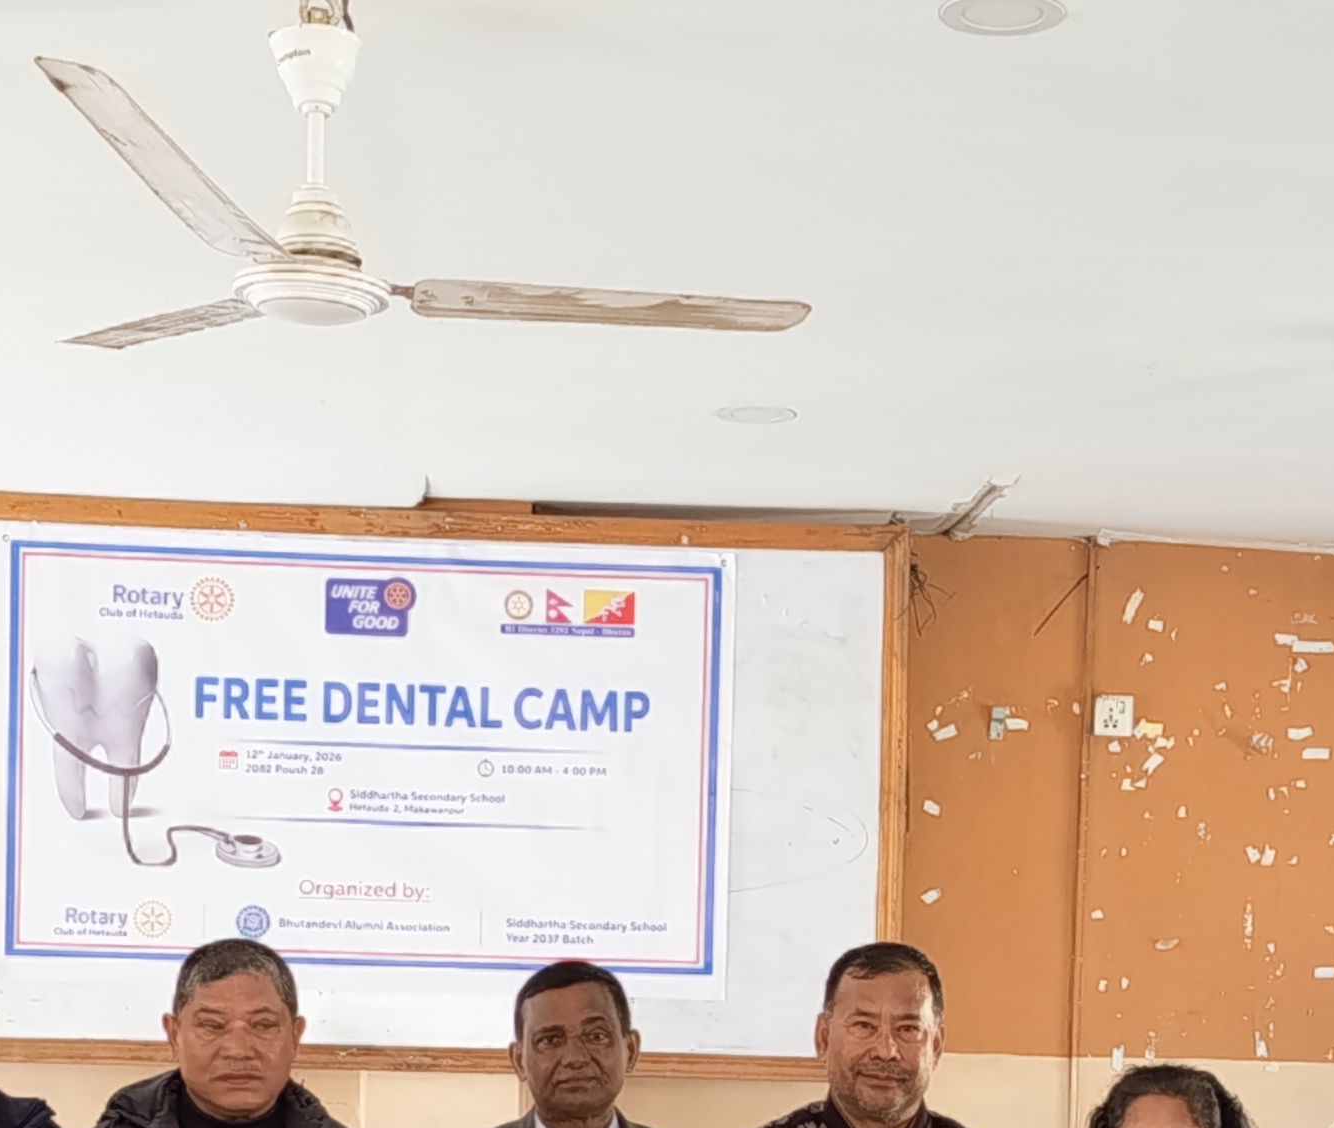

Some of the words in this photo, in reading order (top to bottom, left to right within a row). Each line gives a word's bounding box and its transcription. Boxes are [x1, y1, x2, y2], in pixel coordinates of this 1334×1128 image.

[113, 584, 184, 610] Rotary
[331, 584, 379, 599] UNITE
[99, 607, 123, 618] Club
[126, 608, 137, 618] of
[139, 609, 184, 620] Hetauda
[348, 600, 381, 614] FOR
[352, 615, 400, 630] GOOD
[571, 627, 595, 636] Nepal
[195, 676, 307, 722] FREE
[323, 681, 503, 729] DENTAL
[513, 687, 650, 732] CAMP
[267, 750, 313, 763] January,
[315, 752, 342, 762] 2026
[245, 764, 272, 774] 2082
[275, 764, 308, 774] Poush
[311, 766, 324, 775] 28
[534, 766, 552, 775] AM
[589, 767, 607, 776] PM
[350, 789, 408, 801] Siddhartha
[411, 791, 467, 805] Secondary
[470, 793, 505, 804] School
[349, 803, 389, 813] Hetauda
[404, 805, 464, 815] Makawanpur
[299, 879, 396, 899] Organized
[403, 882, 430, 902] by:
[65, 907, 128, 927] Rotary
[53, 927, 75, 936] Club
[77, 927, 86, 936] of
[88, 928, 128, 937] Hetauda
[279, 918, 342, 930] Bhutandevi
[345, 920, 384, 931] Alumni
[386, 922, 450, 932] Association
[506, 918, 566, 930] Siddhartha
[569, 920, 627, 933] Secondary
[630, 921, 667, 932] School
[506, 933, 529, 943] Year
[533, 934, 559, 944] 2037
[563, 935, 594, 945] Batch
